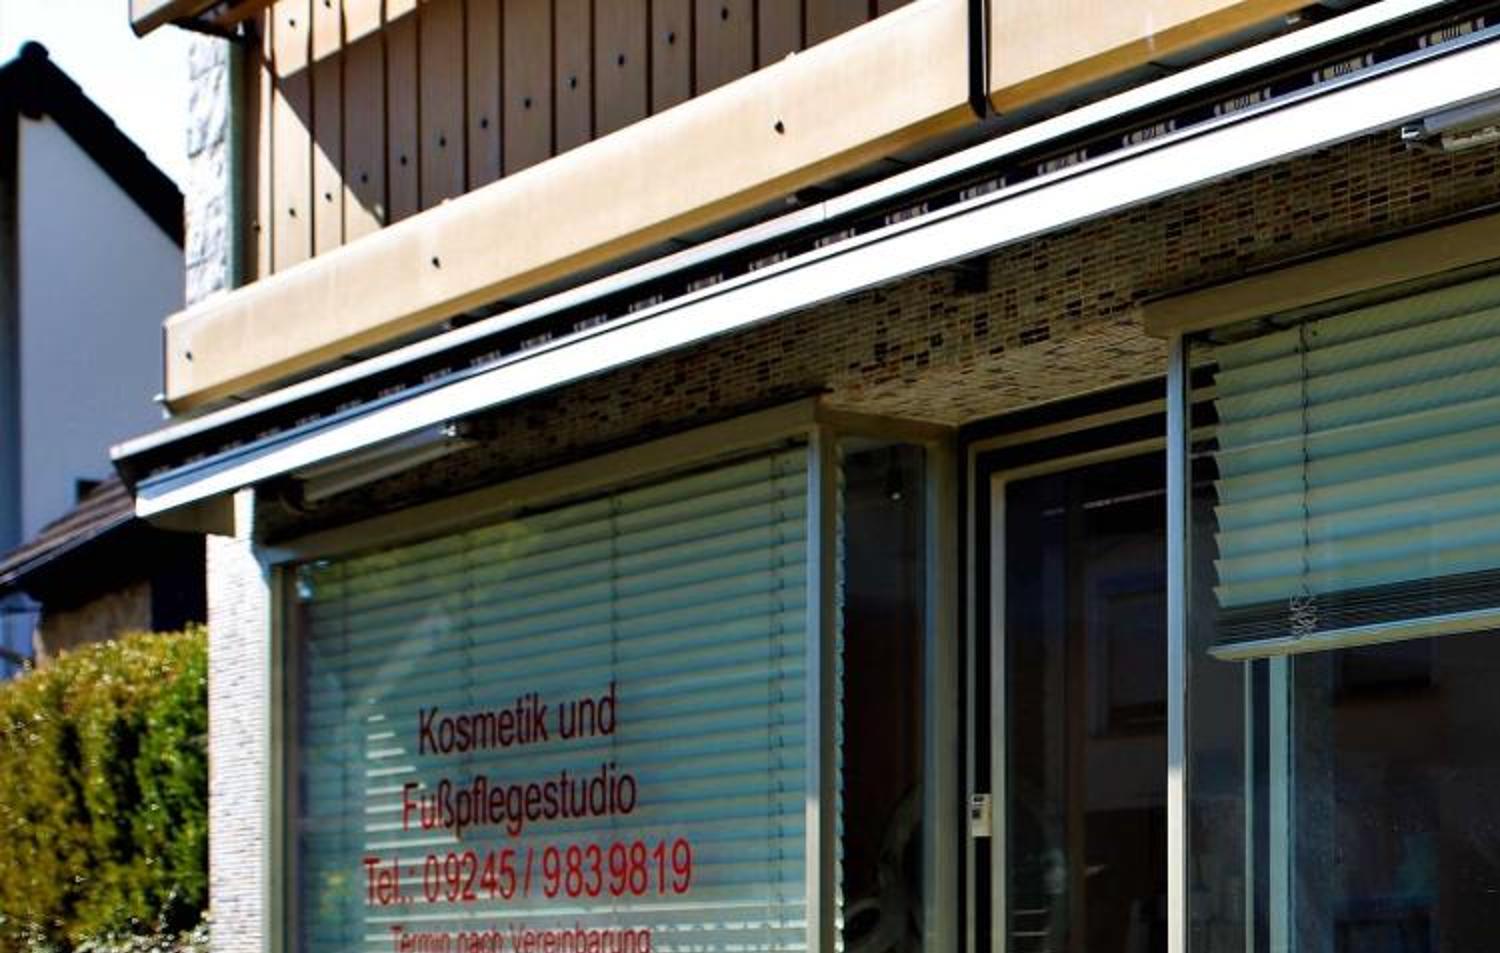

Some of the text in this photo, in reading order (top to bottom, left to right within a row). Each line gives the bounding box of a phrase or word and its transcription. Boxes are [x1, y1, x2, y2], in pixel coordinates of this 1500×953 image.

[418, 681, 616, 755] Kosmetik und
[402, 763, 636, 840] Fußpflegestudio
[424, 848, 517, 903] 09245
